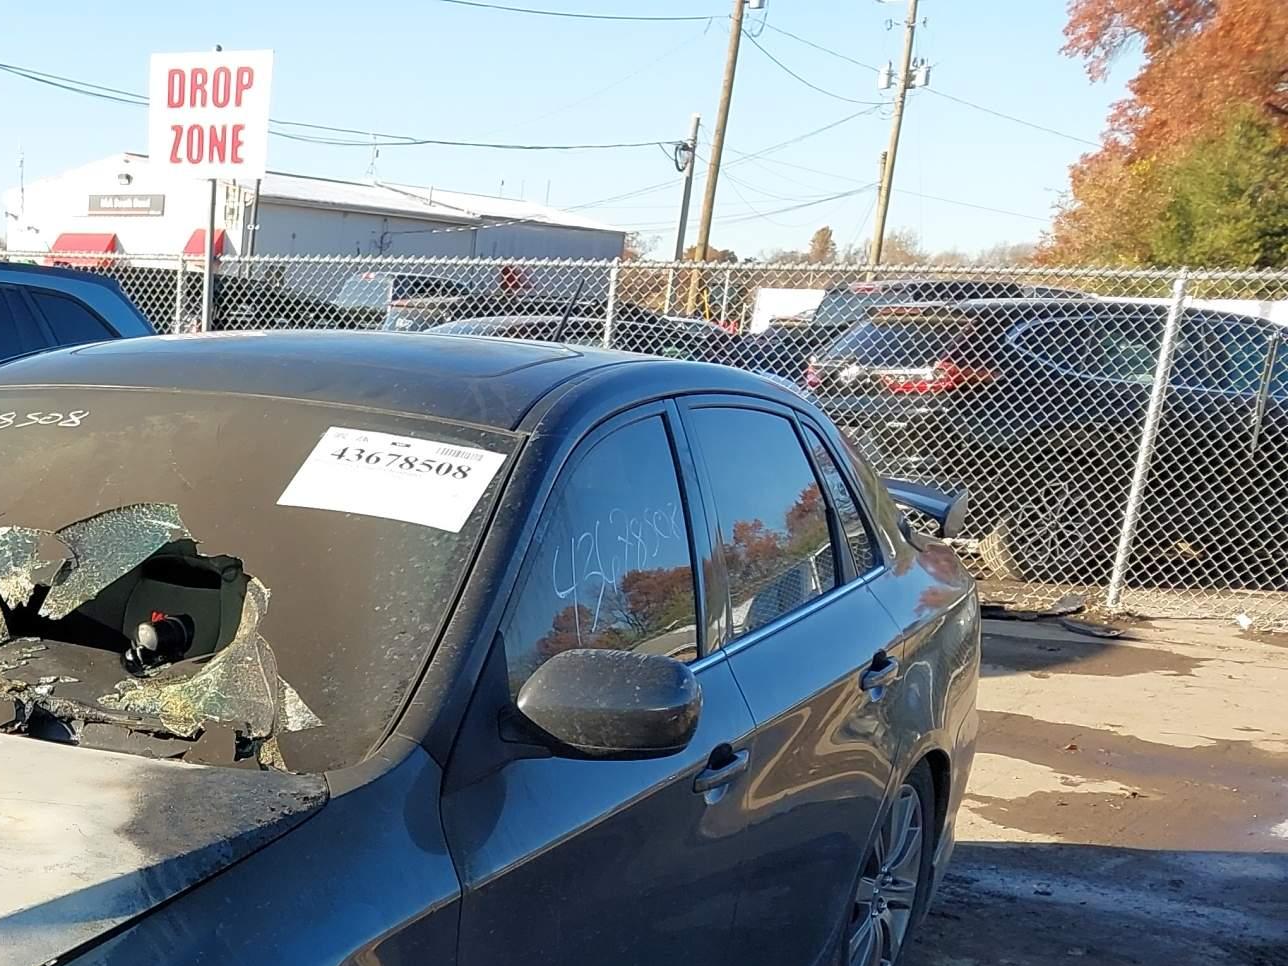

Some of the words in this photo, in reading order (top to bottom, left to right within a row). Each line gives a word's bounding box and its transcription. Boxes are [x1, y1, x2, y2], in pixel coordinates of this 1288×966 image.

[167, 66, 254, 108] DROP
[169, 124, 245, 164] ZONE
[330, 446, 472, 480] 43678508
